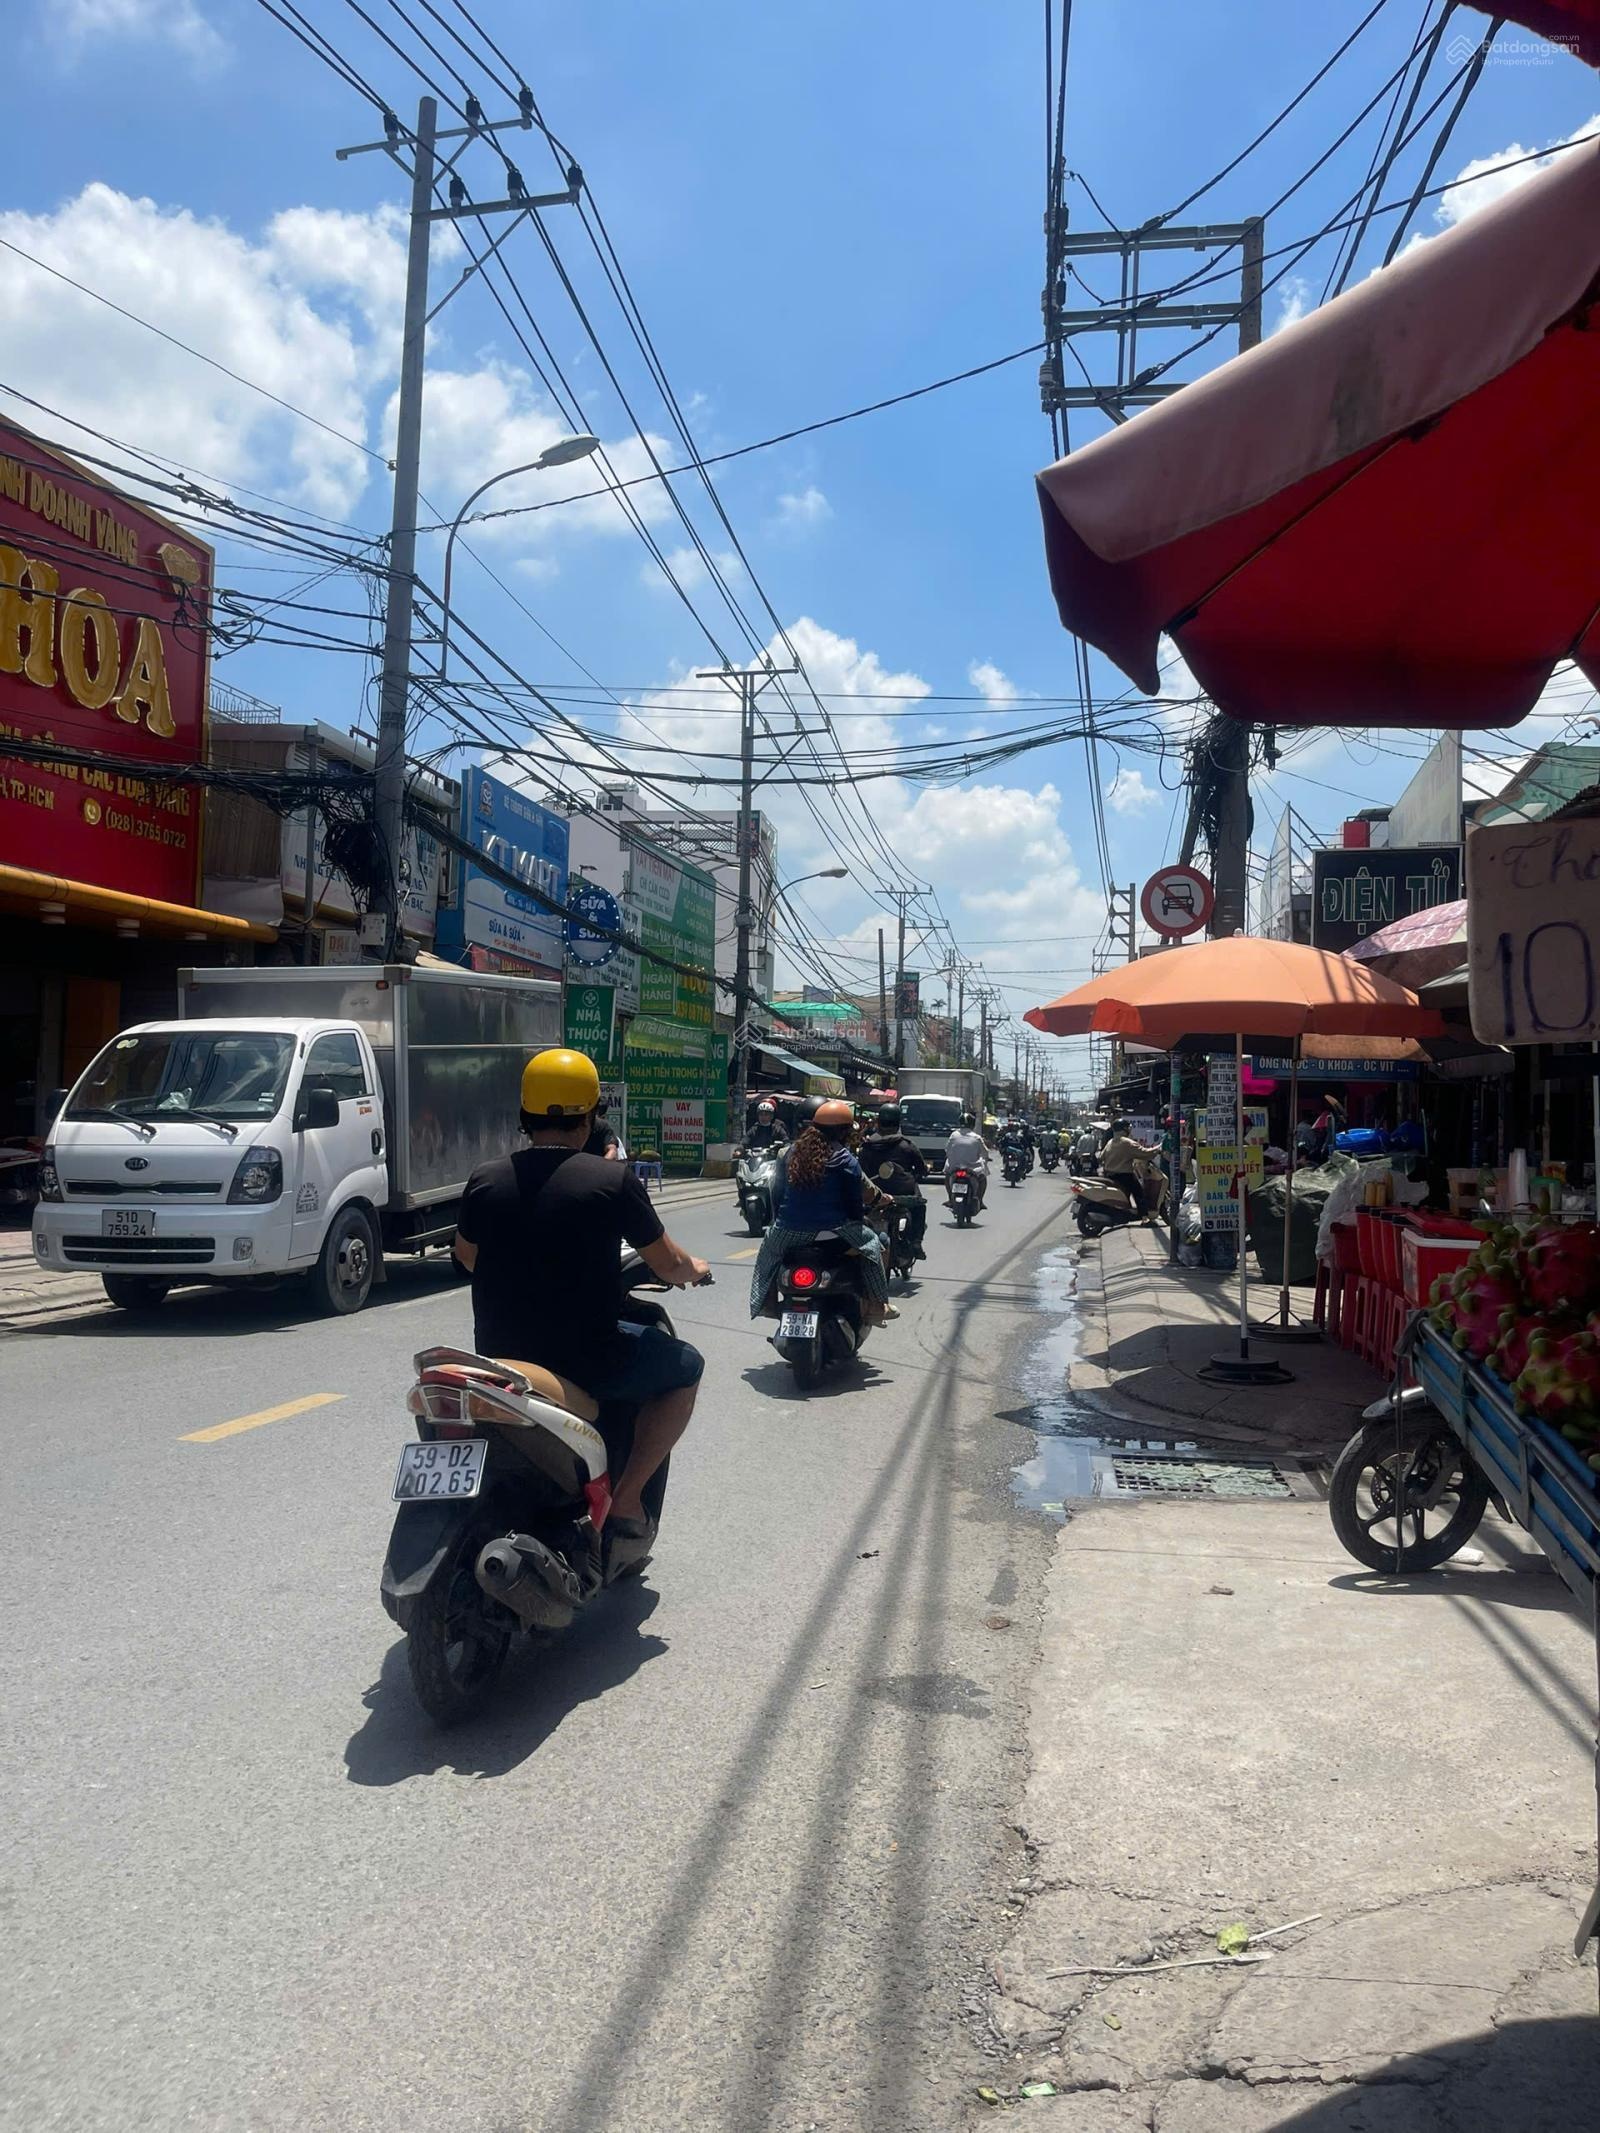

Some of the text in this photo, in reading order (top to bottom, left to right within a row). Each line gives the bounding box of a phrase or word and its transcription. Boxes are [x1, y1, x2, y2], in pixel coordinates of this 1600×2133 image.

[30, 477, 91, 542] DOANH
[96, 507, 139, 568] VÀNG
[1321, 857, 1451, 936] ĐIỆN TỬ
[588, 911, 599, 923] &
[576, 1006, 601, 1022] NHÀ
[567, 1022, 609, 1042] THUỐC
[671, 1068, 698, 1080] TRONG
[675, 1102, 691, 1112] VAY
[127, 1159, 146, 1169] KIA
[1200, 1163, 1232, 1175] TRUNG
[116, 1211, 138, 1224] 51D
[107, 1223, 147, 1237] 759.24
[412, 1445, 474, 1470] 59-D2
